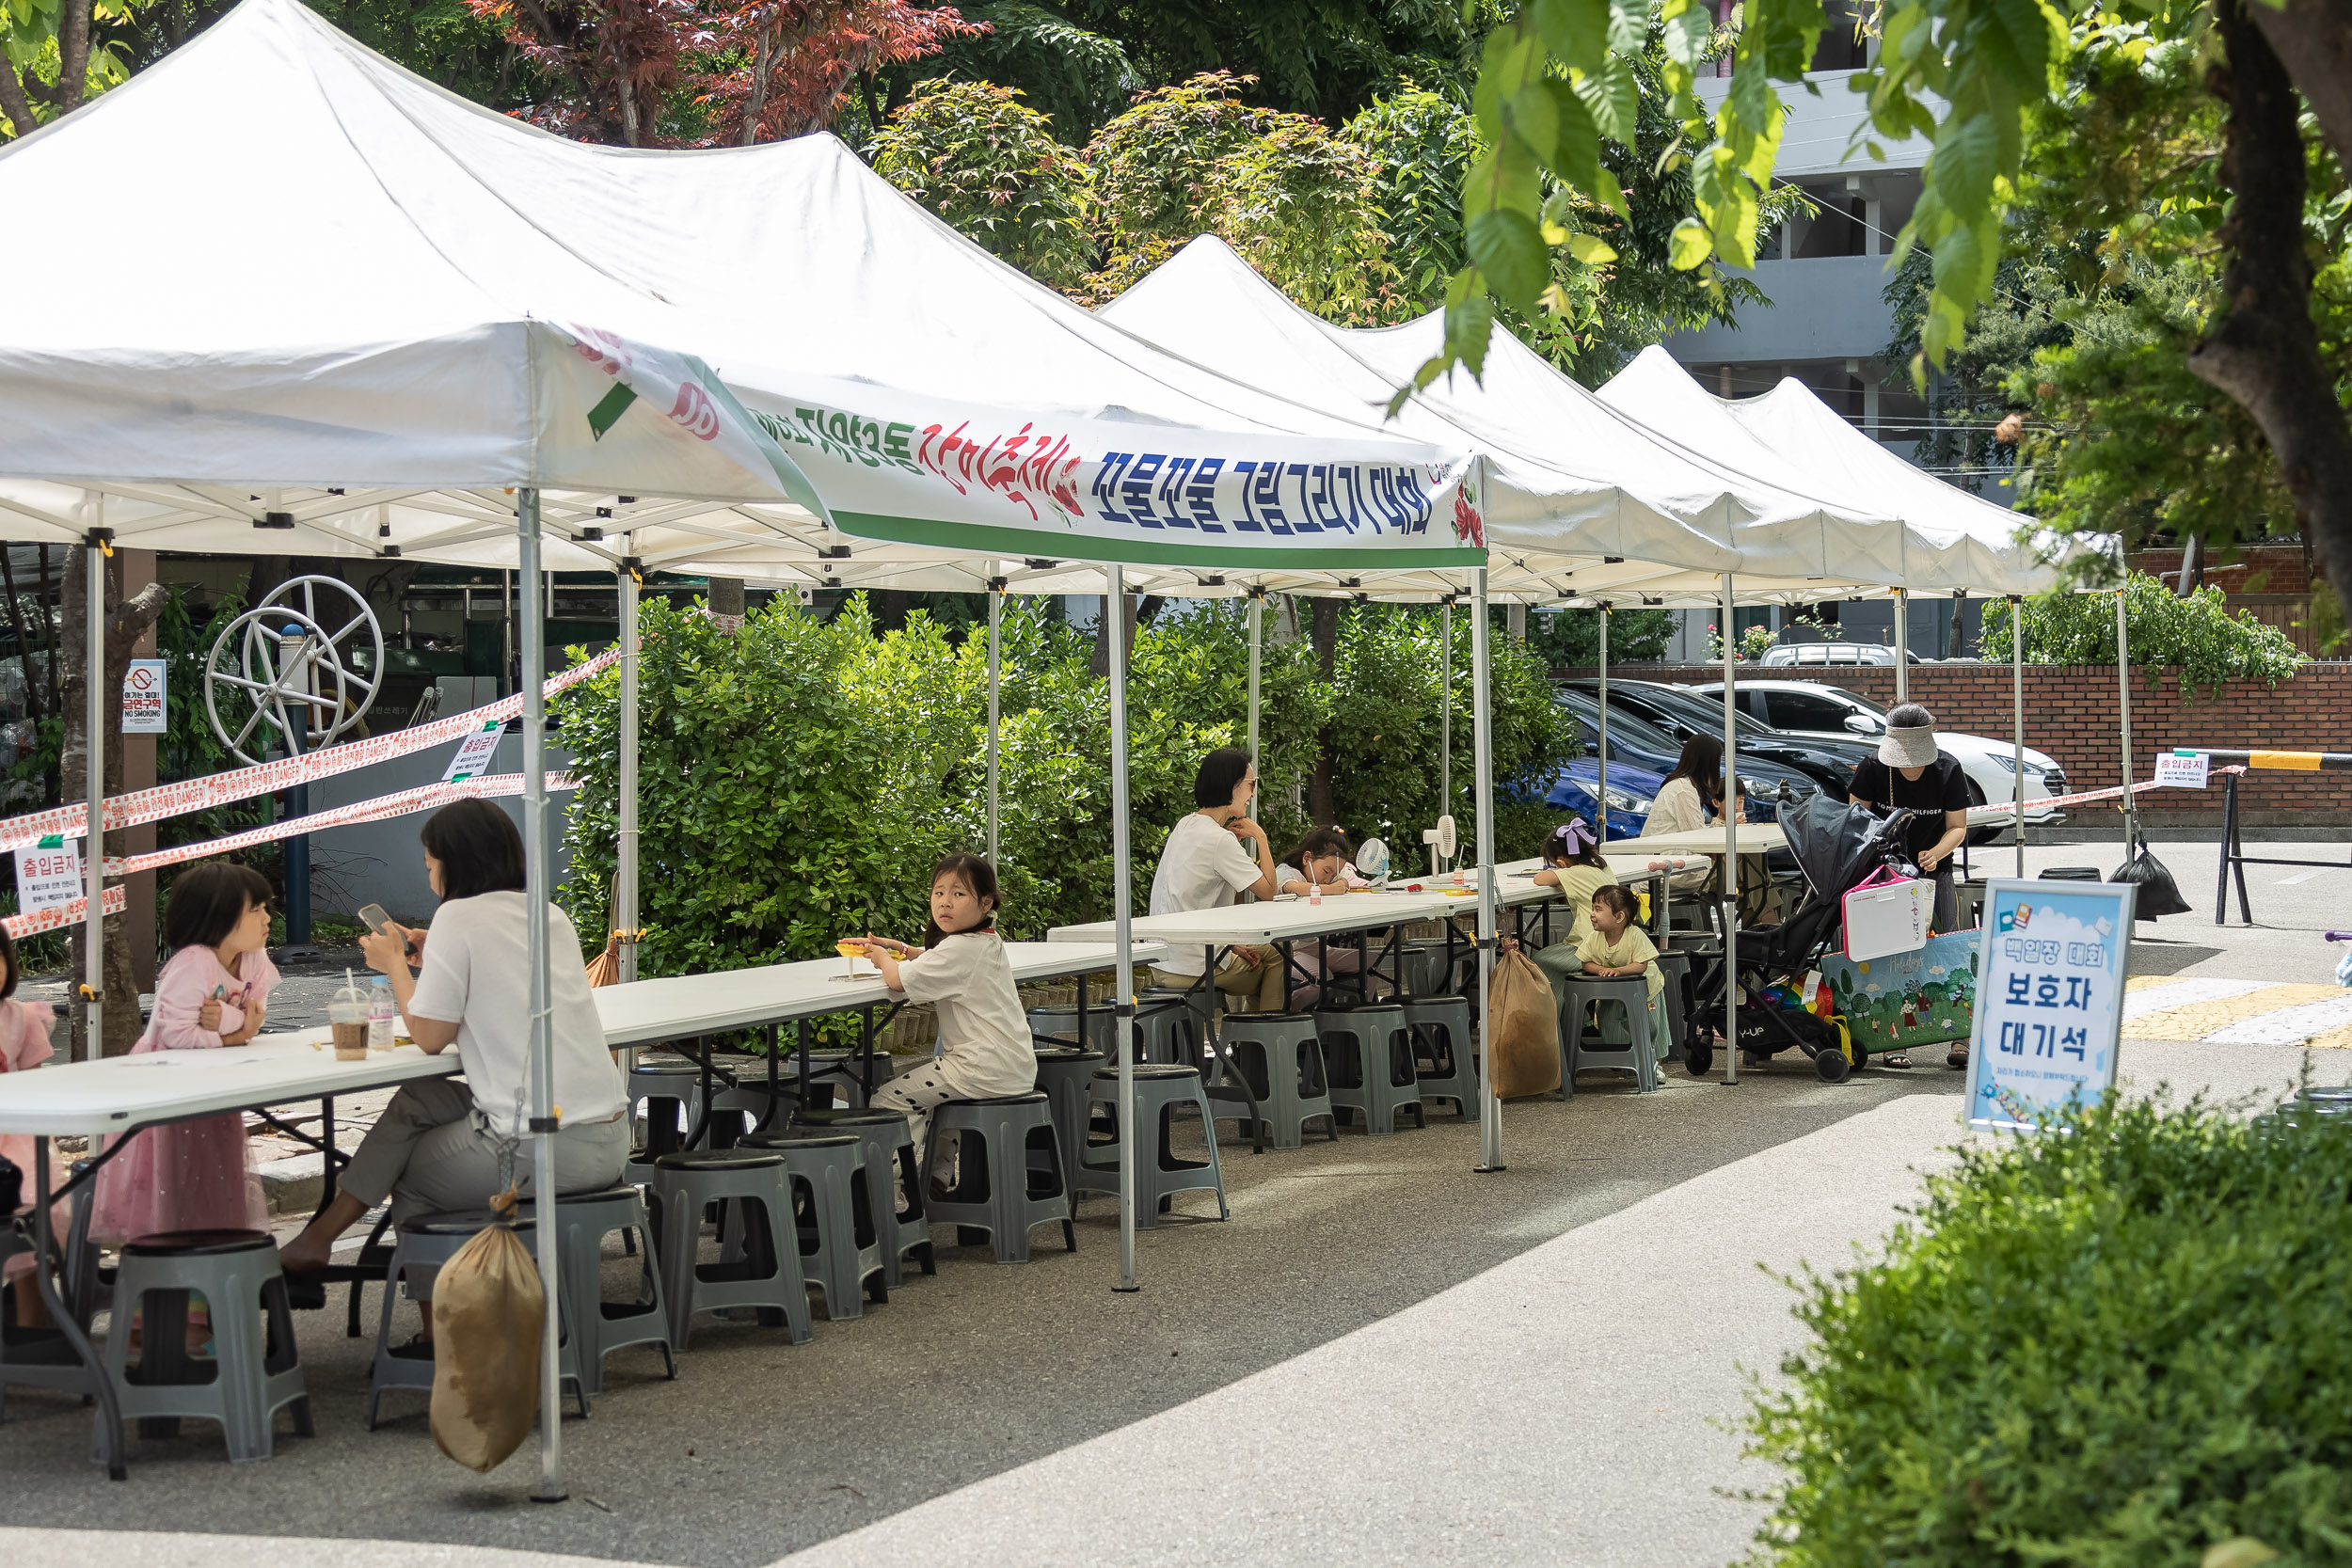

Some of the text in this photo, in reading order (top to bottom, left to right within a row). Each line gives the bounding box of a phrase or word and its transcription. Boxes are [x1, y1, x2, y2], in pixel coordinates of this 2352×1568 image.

[1091, 451, 1228, 533] 꼬물꼬물
[1232, 461, 1382, 535] 그림그리기
[1369, 467, 1433, 535] 대회
[123, 699, 161, 710] 금연구역
[134, 709, 161, 718] SMOKING
[463, 735, 499, 752] 출입금지
[344, 749, 364, 766] 안전제일
[2160, 759, 2203, 769] 출입금지
[251, 771, 273, 789] 안전제일
[275, 765, 301, 783] DANGER!
[151, 793, 175, 812] 안전제일
[176, 786, 206, 806] DANGER!
[31, 818, 61, 837] 안전제일
[24, 853, 75, 878] 출입금지
[1889, 951, 1924, 973] Holidays
[2005, 937, 2105, 968] 백일장 대회
[2005, 973, 2092, 1011] 보호자
[2000, 1021, 2088, 1062] 대기석
